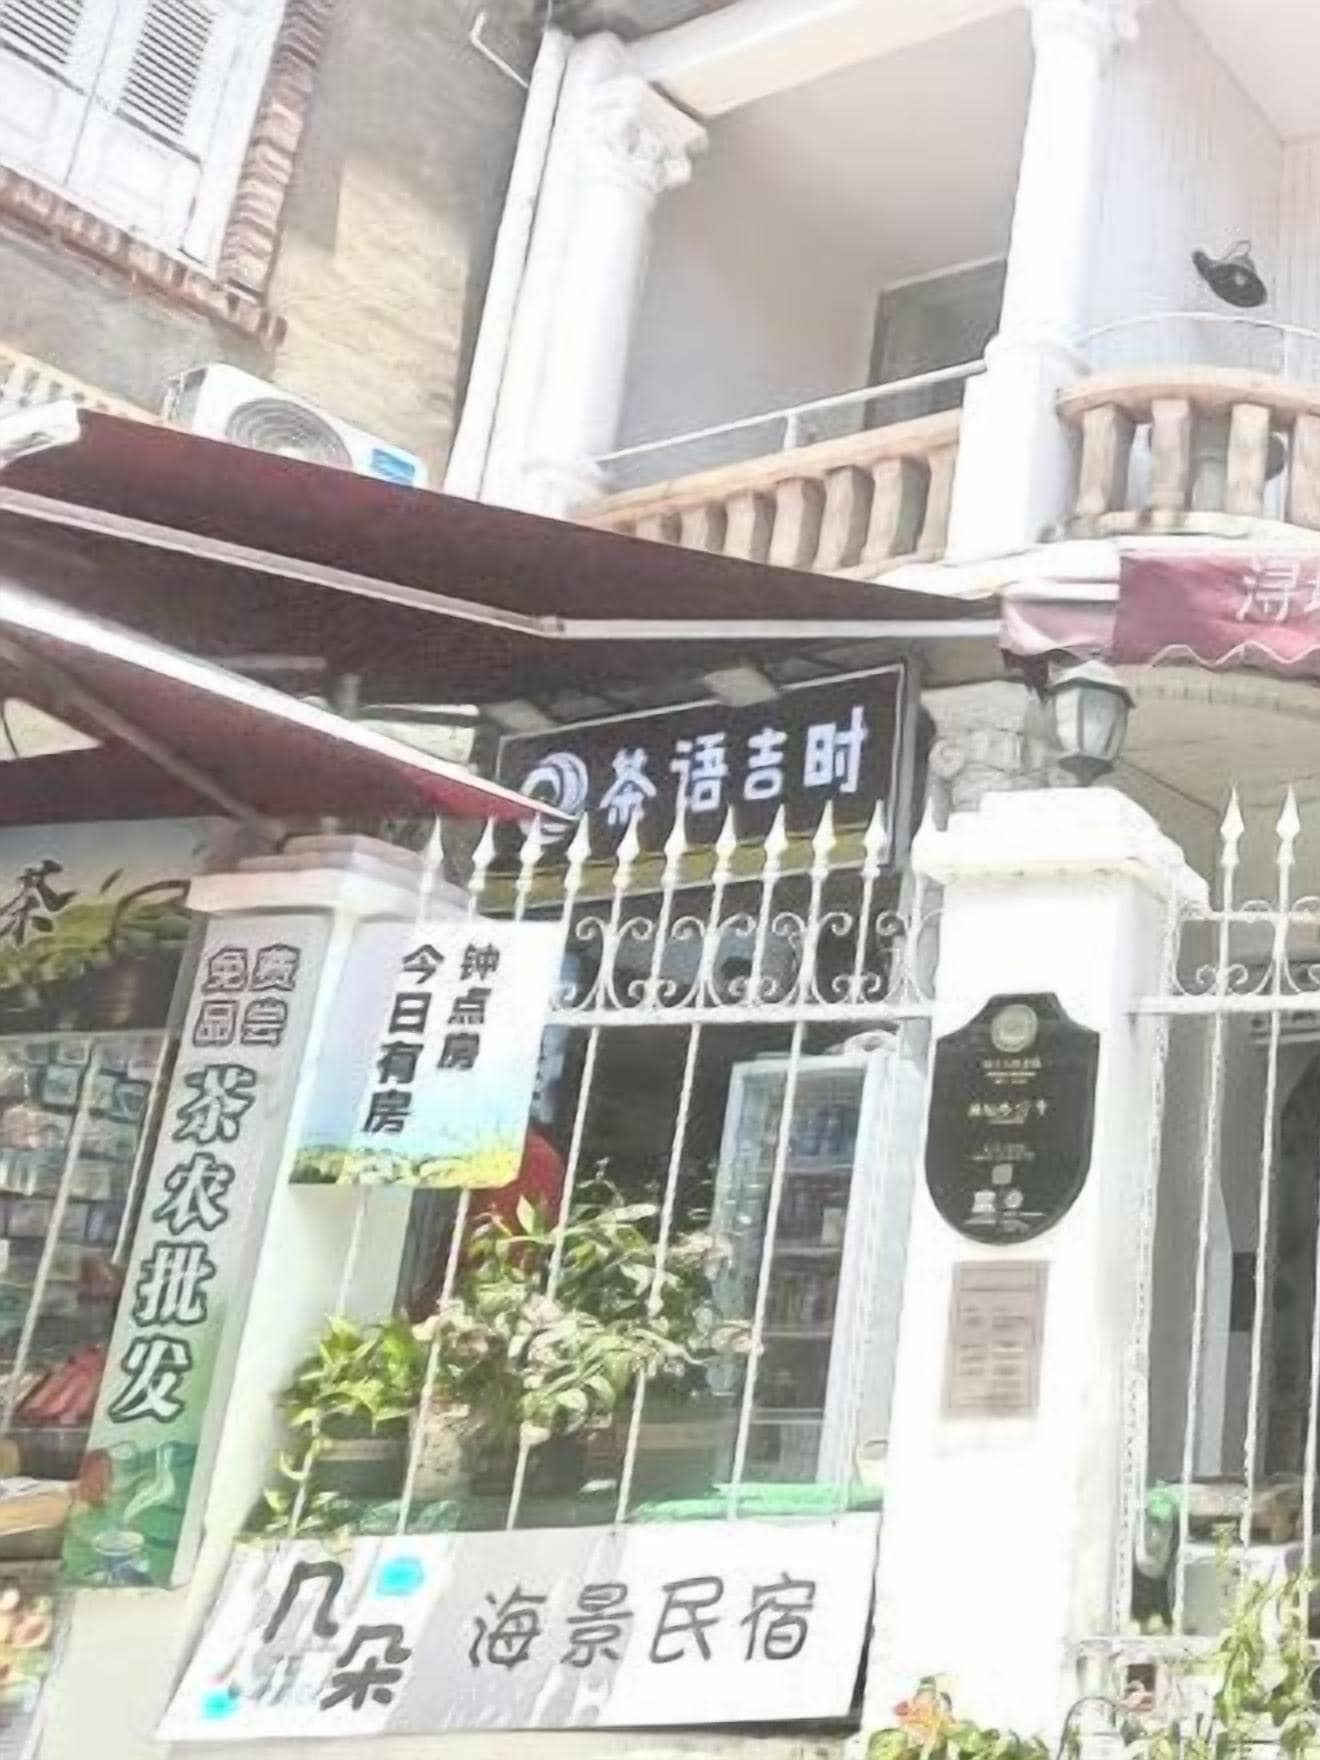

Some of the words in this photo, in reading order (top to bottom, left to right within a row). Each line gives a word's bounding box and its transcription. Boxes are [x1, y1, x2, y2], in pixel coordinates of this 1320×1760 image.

[600, 705, 868, 826] 茶语吉时
[361, 944, 445, 1133] 今日有房
[437, 943, 500, 1071] 钟点房
[108, 1064, 257, 1424] 茶农批发
[468, 1571, 816, 1671] 海景民宿
